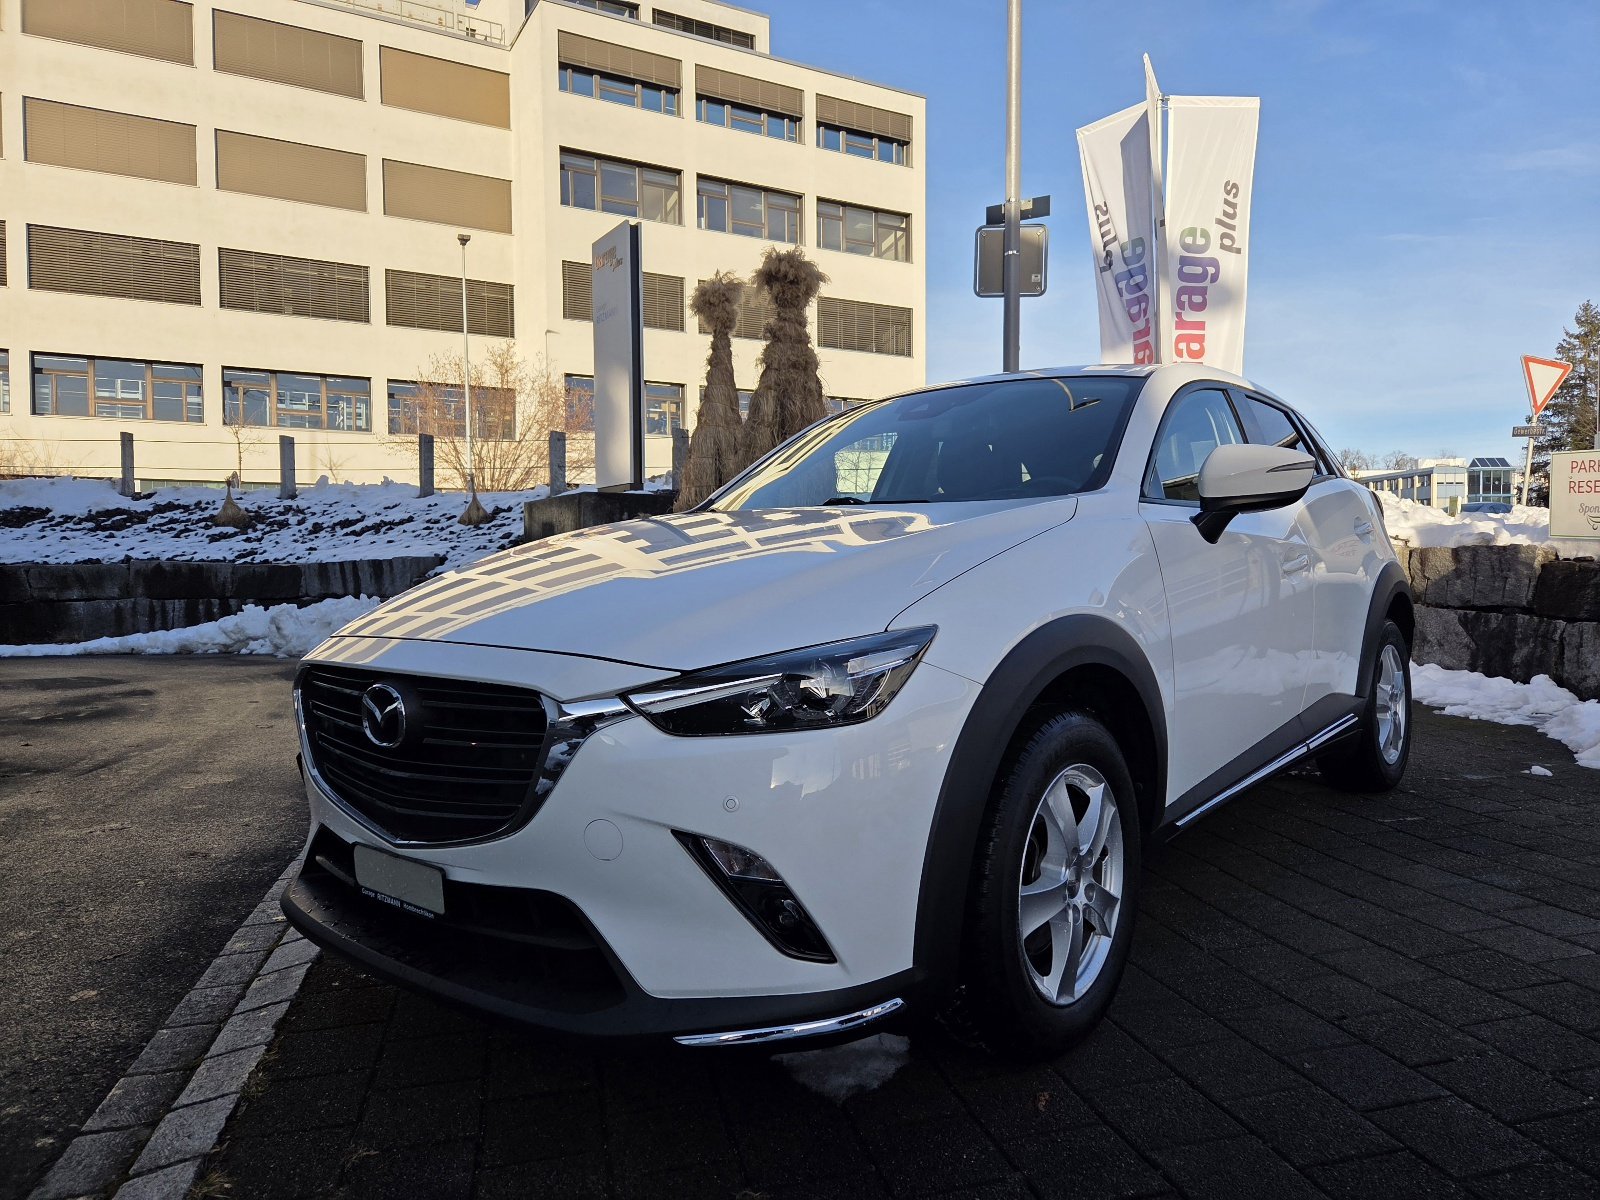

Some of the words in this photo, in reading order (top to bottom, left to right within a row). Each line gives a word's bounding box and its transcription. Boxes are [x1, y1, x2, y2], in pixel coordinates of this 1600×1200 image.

[1215, 180, 1242, 254] plus
[1173, 227, 1220, 364] arage
[1578, 502, 1600, 516] Spon
